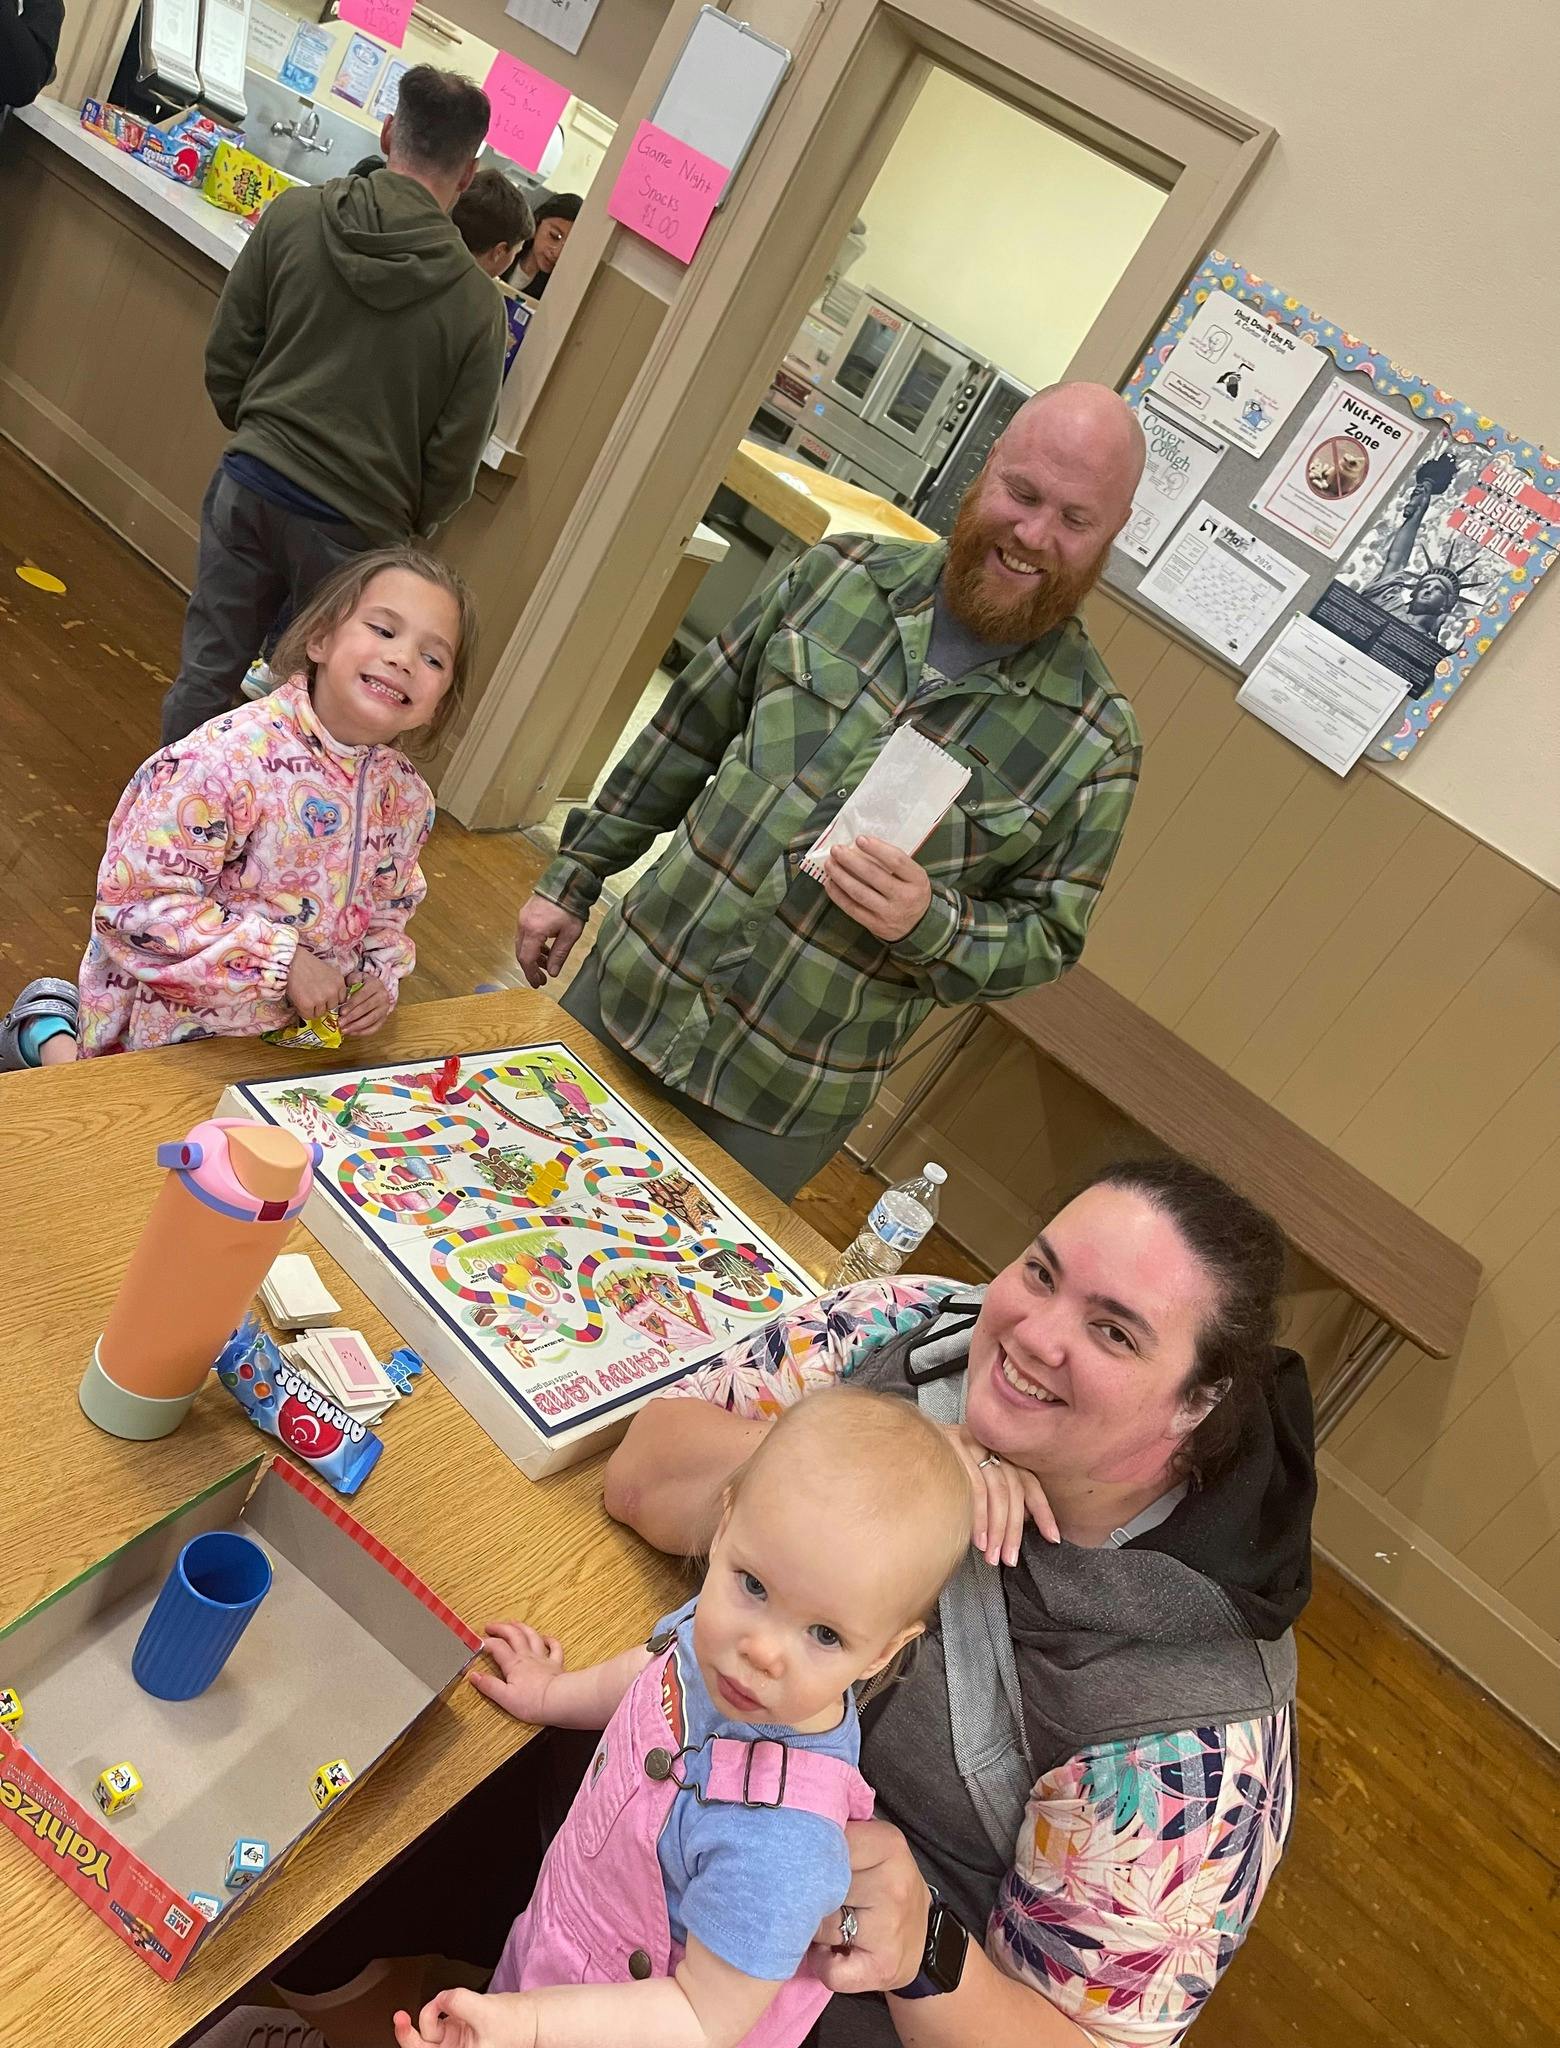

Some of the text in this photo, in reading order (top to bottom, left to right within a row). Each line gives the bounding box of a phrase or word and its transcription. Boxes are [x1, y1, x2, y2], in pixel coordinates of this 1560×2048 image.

[637, 134, 712, 194] Game Night
[638, 175, 680, 212] Snacks
[1234, 309, 1297, 351] Shut Down the Flu
[1143, 414, 1185, 449] Cover
[1342, 398, 1402, 440] Nut-Free
[1344, 422, 1380, 450] Zone
[1150, 438, 1191, 472] Cough
[1459, 516, 1489, 543] FOR
[1475, 495, 1533, 535] JUSTICE
[380, 1181, 435, 1192] MOUNTAIN PASS
[533, 1347, 671, 1416] CANDY LAND
[273, 1363, 368, 1444] AIRHEADS
[0, 1779, 112, 1892] Yahtze
[166, 1913, 188, 1936] MB
